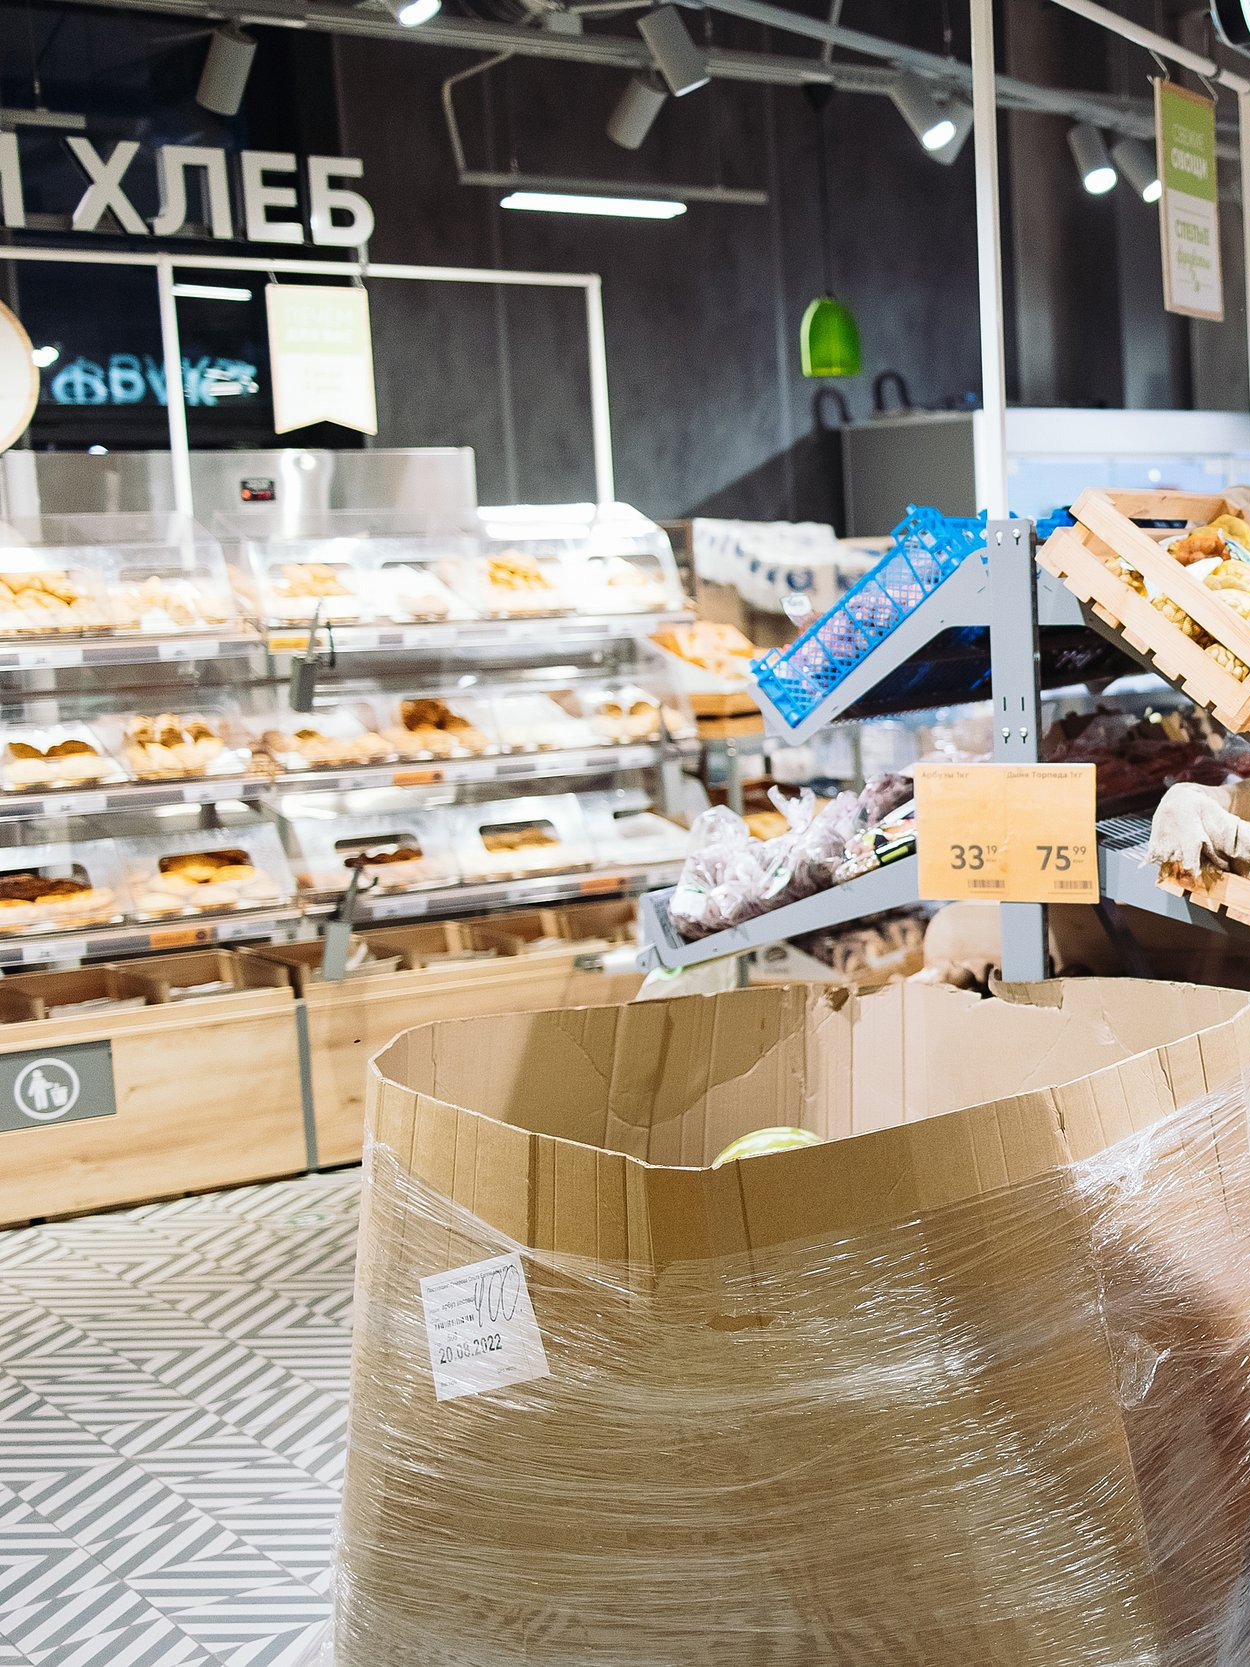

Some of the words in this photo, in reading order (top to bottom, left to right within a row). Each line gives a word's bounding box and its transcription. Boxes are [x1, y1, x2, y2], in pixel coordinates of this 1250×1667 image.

[66, 136, 375, 247] ХЛЕБ
[1032, 771, 1068, 780] Торпеда
[951, 845, 985, 871] 33
[986, 845, 998, 855] 19
[1036, 845, 1071, 871] 75
[1072, 846, 1087, 855] 99
[439, 1333, 502, 1364] 20.08.2022
